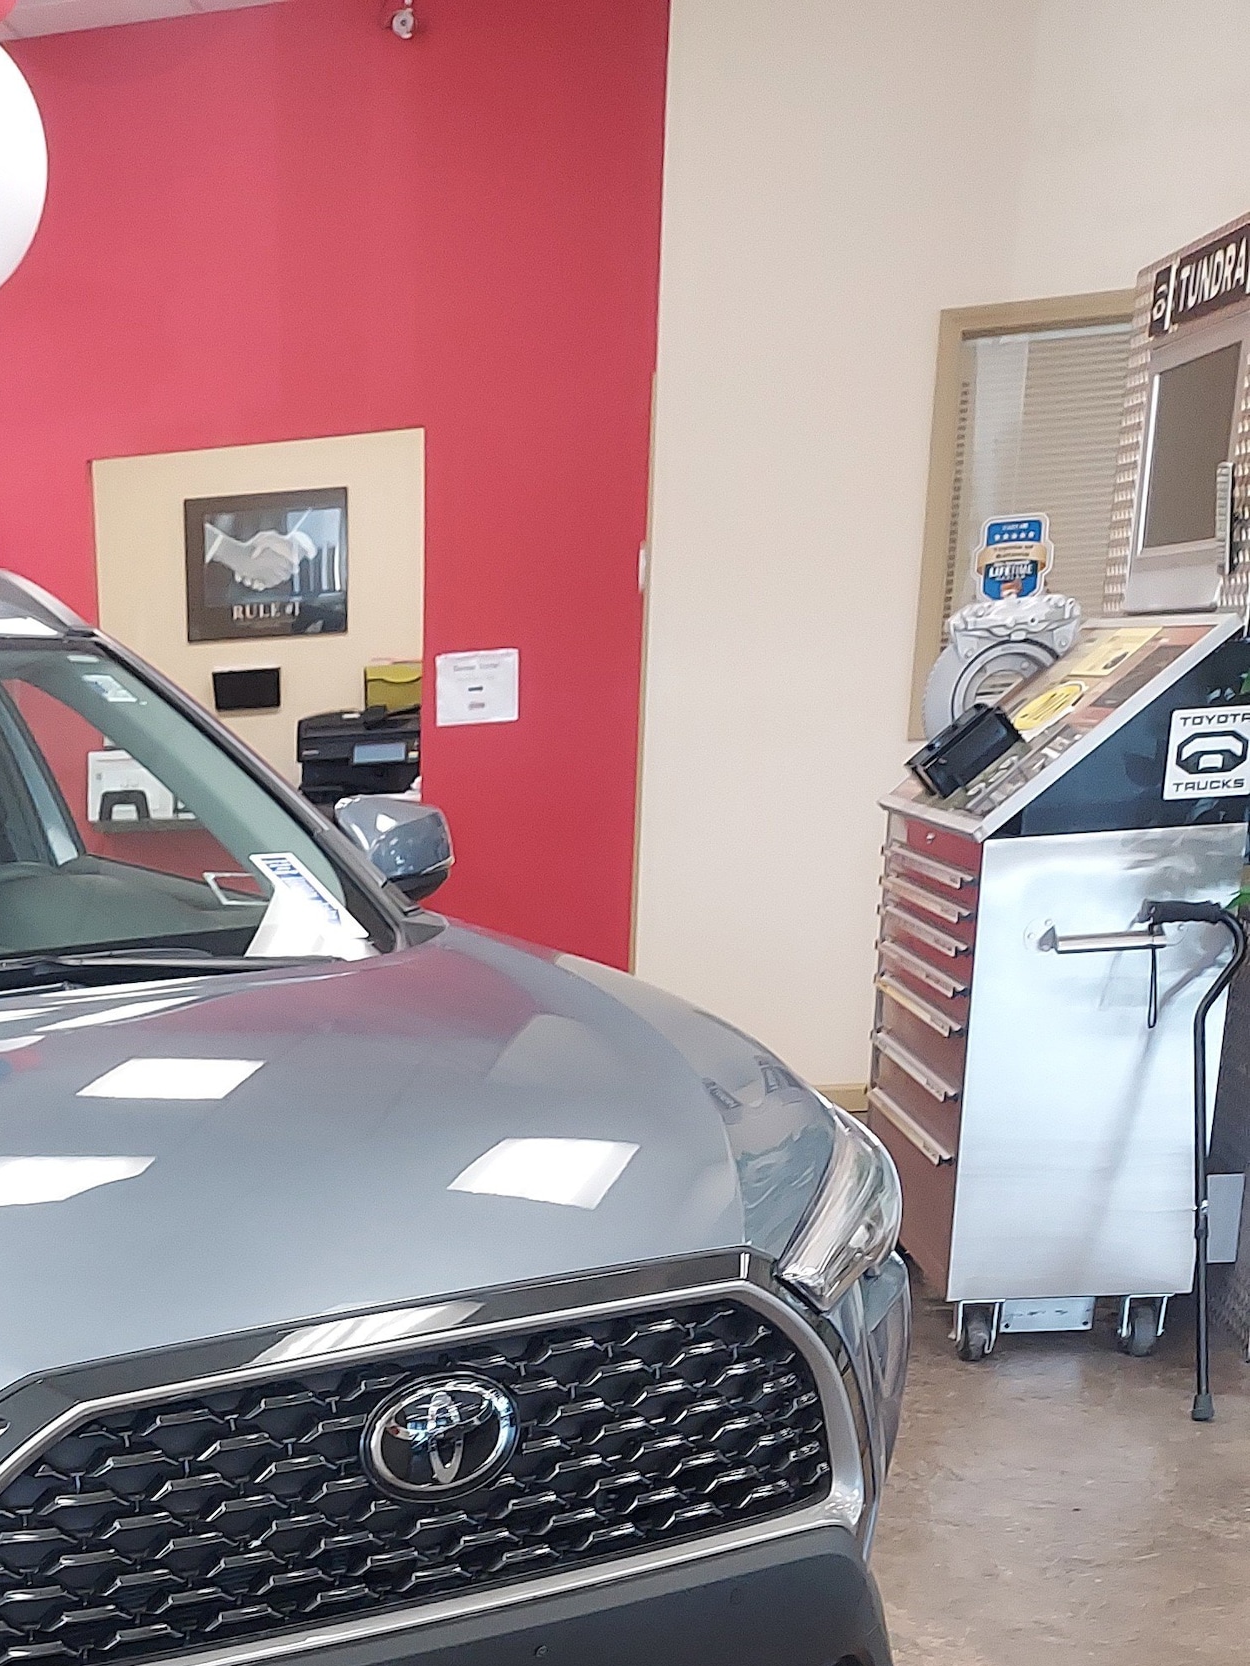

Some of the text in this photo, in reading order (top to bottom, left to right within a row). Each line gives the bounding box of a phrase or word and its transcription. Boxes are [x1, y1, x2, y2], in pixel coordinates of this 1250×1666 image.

[1178, 237, 1247, 312] TUNDRA
[232, 602, 281, 620] RULE
[1172, 778, 1246, 793] TRUCKS
